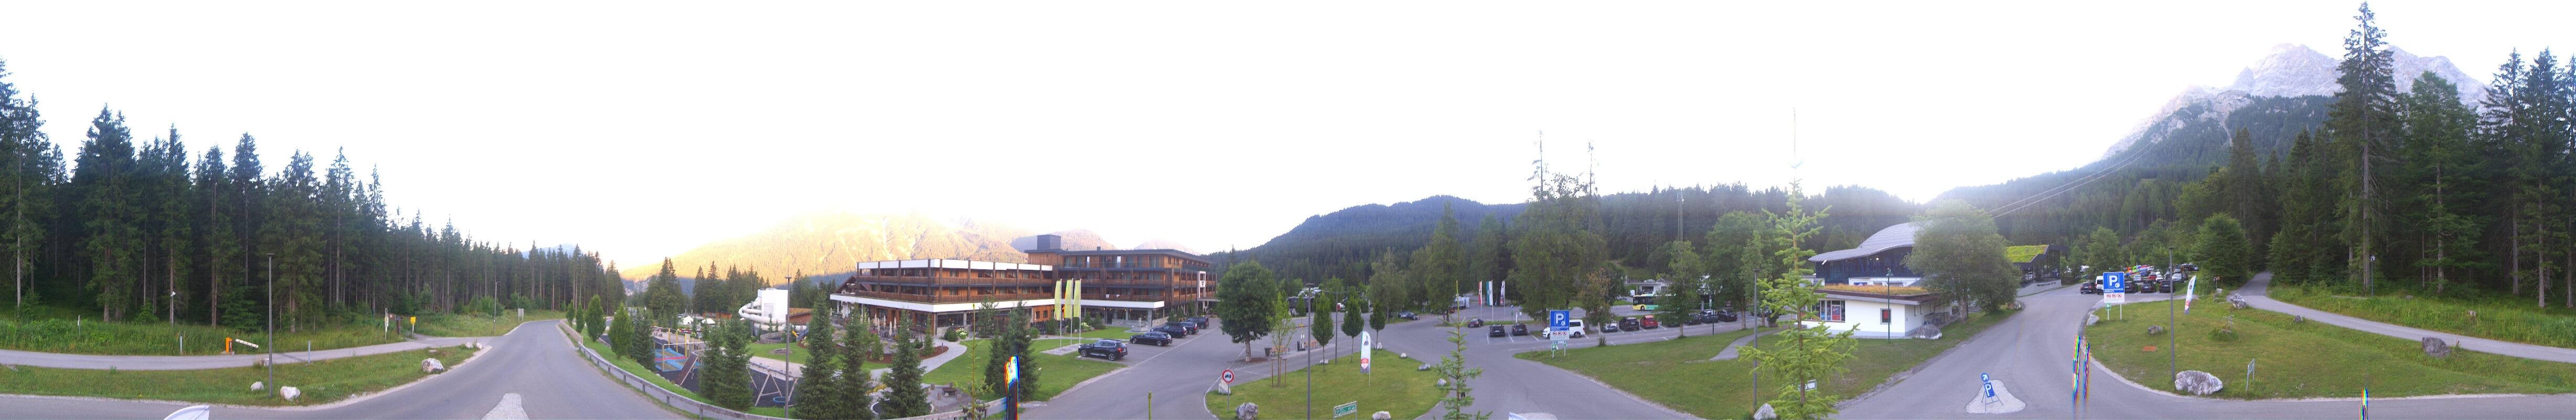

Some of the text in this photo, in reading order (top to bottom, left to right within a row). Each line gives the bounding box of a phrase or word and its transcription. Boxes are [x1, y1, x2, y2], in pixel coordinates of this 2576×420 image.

[2108, 275, 2118, 286] P
[1555, 313, 1564, 324] P
[1985, 384, 1991, 396] P
